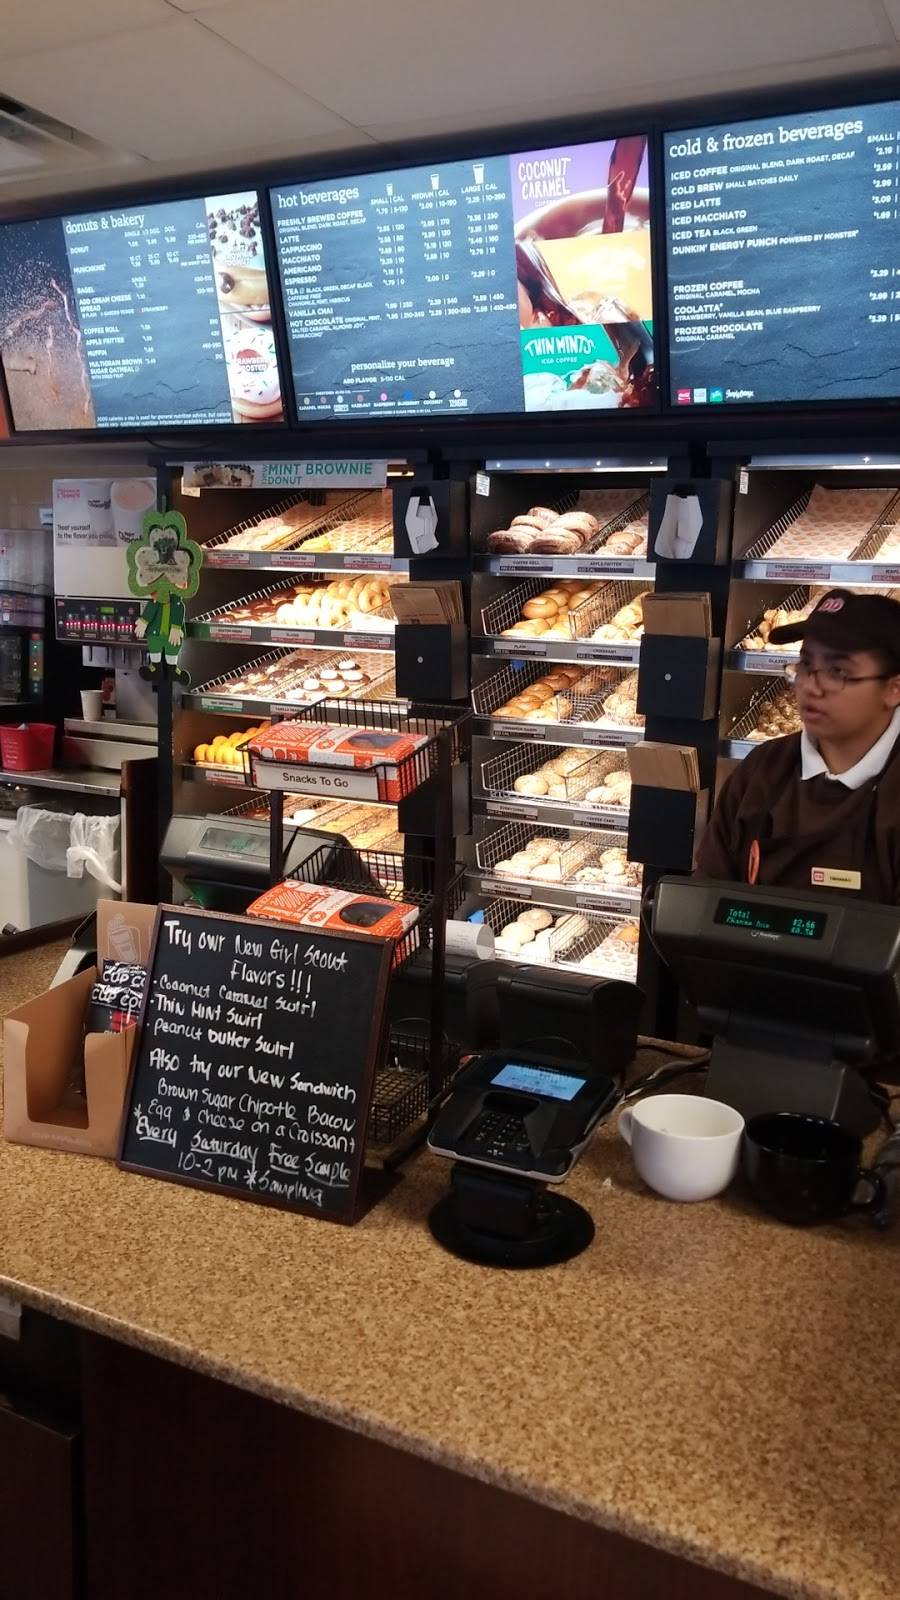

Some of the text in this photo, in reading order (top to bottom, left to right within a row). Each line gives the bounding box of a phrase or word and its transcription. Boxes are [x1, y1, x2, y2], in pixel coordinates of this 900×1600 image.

[669, 121, 864, 159] cold & frozen beverages
[867, 134, 895, 144] SMALL
[518, 157, 573, 183] COCONUT
[671, 171, 691, 181] ICED
[693, 165, 729, 179] COFFEE
[786, 156, 805, 167] DARK
[831, 151, 856, 161] DECAF
[522, 178, 572, 201] CARAMEL
[671, 174, 799, 196] COLD BREW SMALL BATCHES DAILY
[277, 187, 360, 209] hot beverages
[671, 196, 721, 212] ICED LATTE
[65, 214, 146, 235] donuts & bakery
[277, 209, 364, 228] FRESHLY BREWED COFFEE
[672, 209, 747, 226] ICED MACCHIATO
[279, 235, 300, 245] LATTE
[672, 230, 693, 241] ICED
[694, 228, 712, 239] TEA
[280, 243, 323, 255] CAPPUCCINO
[709, 239, 745, 252] ENERGY
[747, 236, 778, 248] PUNCH
[282, 254, 321, 265] MACCHIATO
[283, 264, 322, 276] AMERICANO
[284, 275, 318, 286] ESPRESSO
[673, 279, 744, 295] FROZEN COFFEE
[286, 287, 299, 297] TEA
[289, 307, 334, 318] VANILLA CHAI
[290, 319, 303, 329] HOT
[304, 316, 344, 327] CHOCOLATE
[674, 321, 764, 337] FROZEN CHOCOLATE
[83, 327, 104, 336] COFFEE
[90, 364, 135, 375] SUGAR OATMEAL
[351, 356, 455, 373] personalize your beverage
[342, 377, 355, 386] ADD
[354, 376, 377, 385] FLAVOR
[268, 463, 373, 476] MINT BROWNIE
[268, 476, 302, 485] DONUT
[282, 772, 349, 789] Snacks To Go
[729, 908, 751, 920] Total
[163, 920, 192, 955] Try
[234, 933, 263, 958] New
[269, 938, 299, 966] Girl
[303, 943, 349, 973] Scout
[225, 1006, 263, 1030] Swirl
[153, 1017, 203, 1041] Peanut
[254, 1035, 295, 1060] Swirl
[149, 1047, 357, 1105] Also try our New Sandwich
[157, 1077, 356, 1132] Brown Sugar Chipotle Bacon
[250, 1121, 270, 1134] on
[275, 1125, 287, 1137] a
[288, 1121, 356, 1153] Croissant
[135, 1114, 352, 1185] Every Saturday Free Sample
[177, 1151, 216, 1177] 10-2
